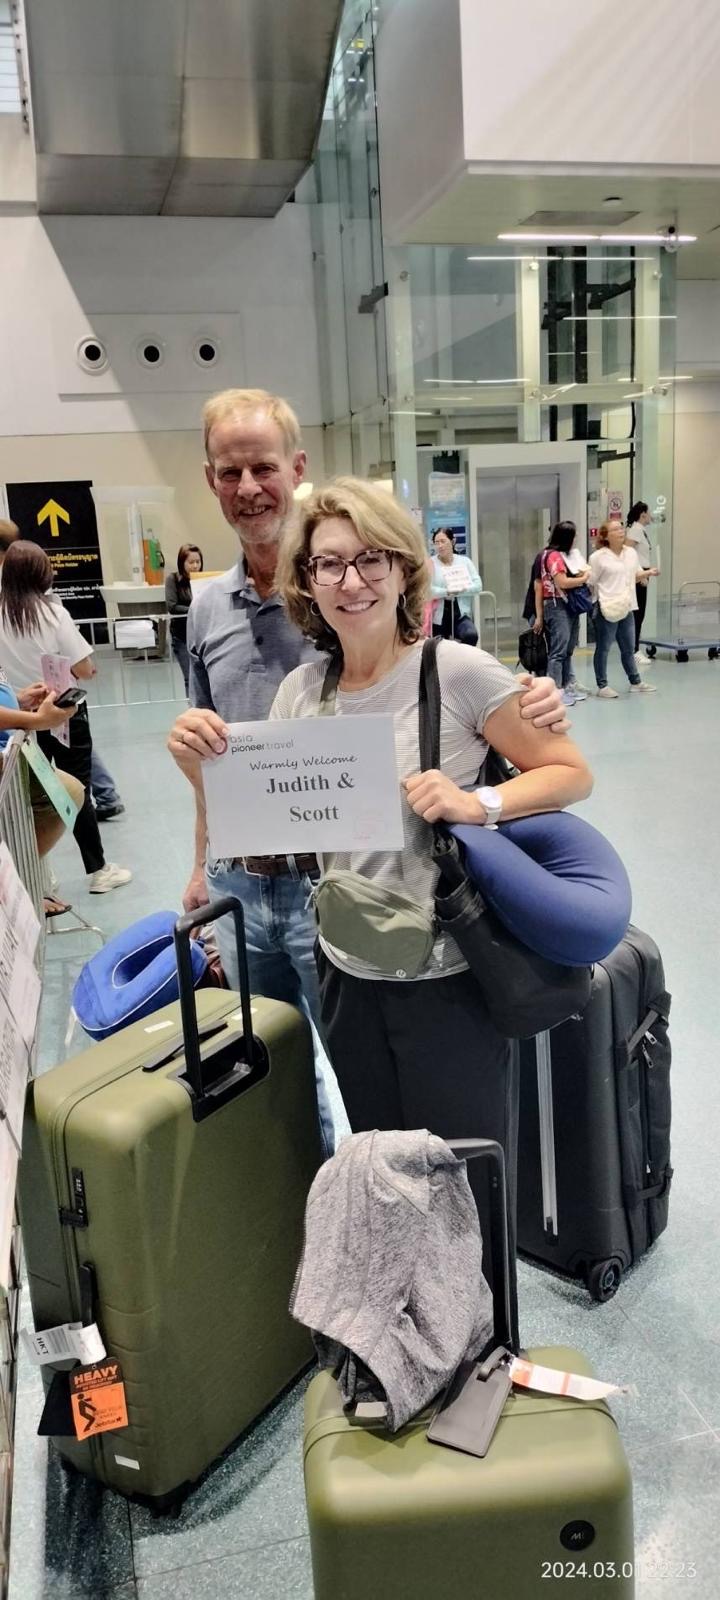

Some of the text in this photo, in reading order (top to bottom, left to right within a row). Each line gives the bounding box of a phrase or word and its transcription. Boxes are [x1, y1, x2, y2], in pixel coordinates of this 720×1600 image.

[230, 735, 253, 744] asia
[231, 743, 265, 755] pioneer
[250, 755, 357, 771] Warmly Welcome
[266, 772, 355, 794] Judith &
[289, 806, 340, 822] Scott
[74, 1365, 118, 1385] HEAVY
